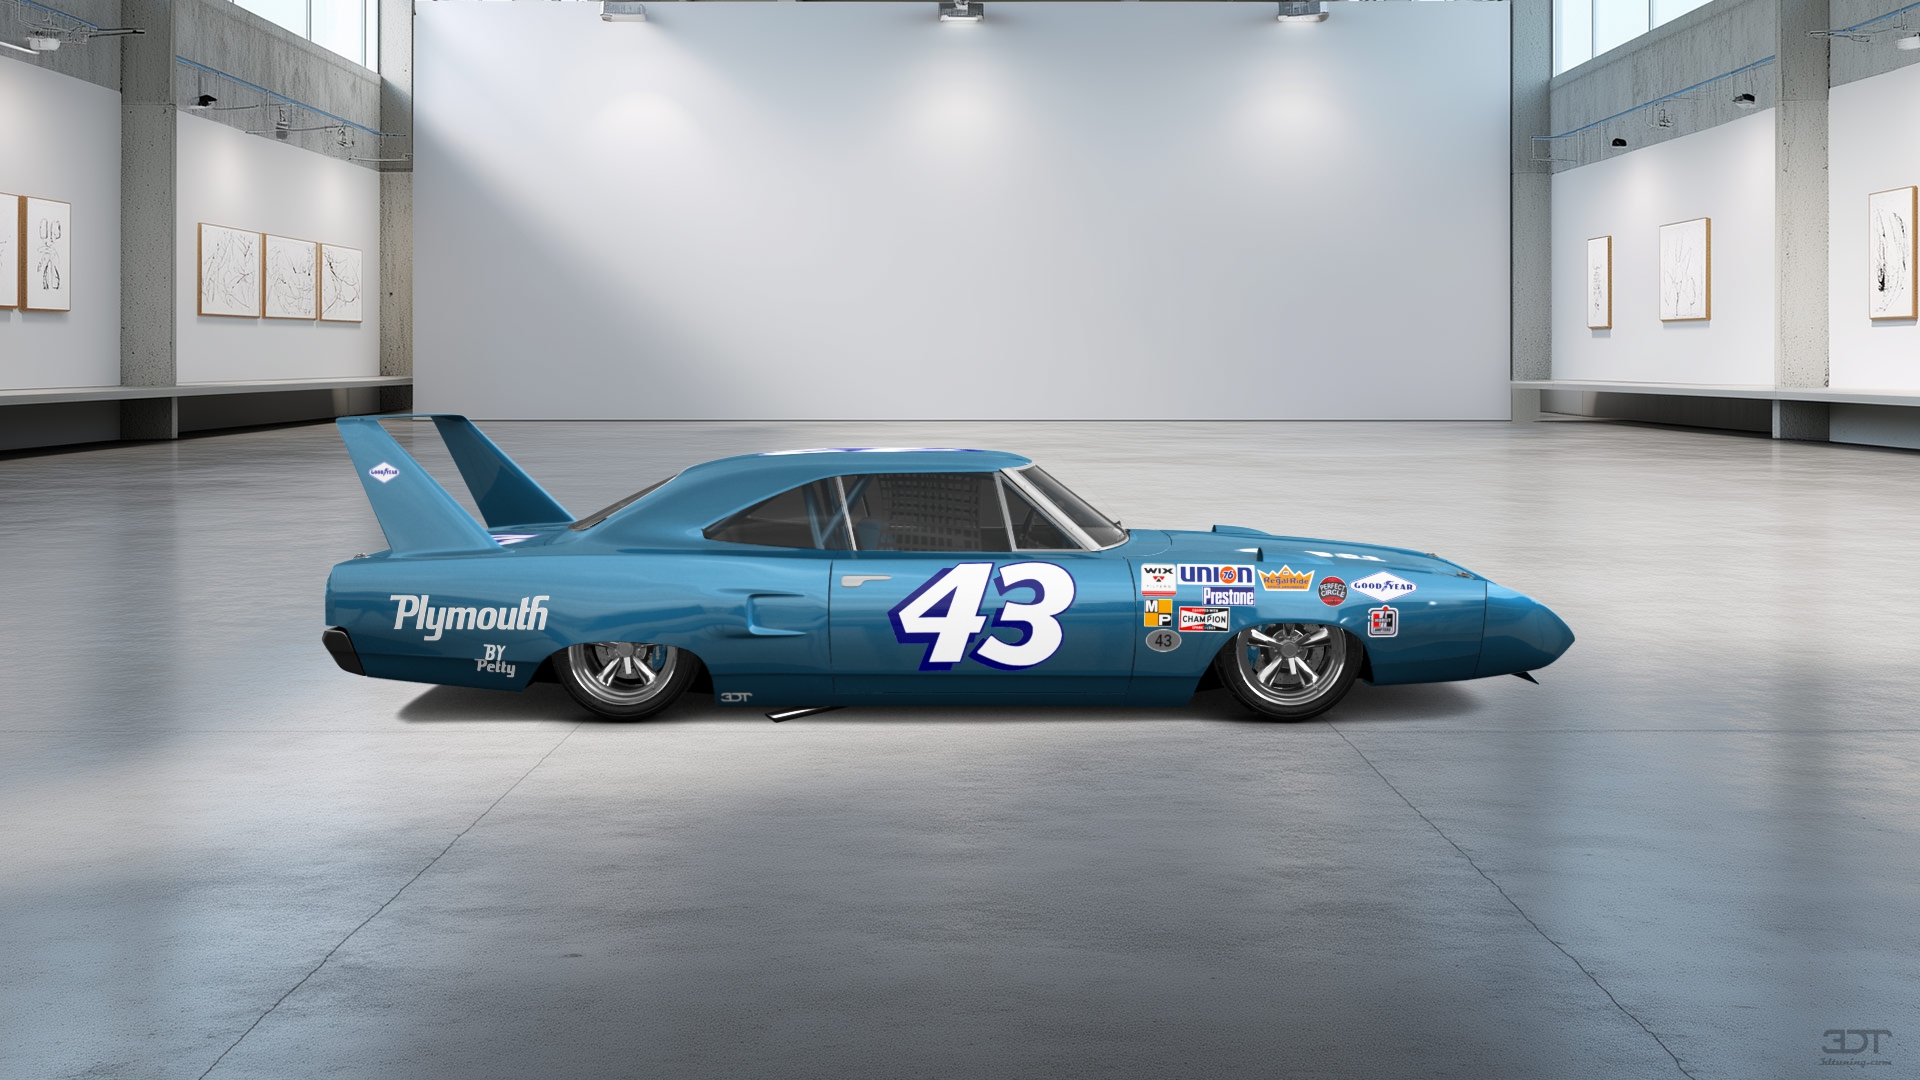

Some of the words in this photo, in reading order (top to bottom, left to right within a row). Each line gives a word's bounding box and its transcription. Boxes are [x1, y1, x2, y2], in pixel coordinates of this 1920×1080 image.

[1222, 571, 1233, 579] 76
[1203, 587, 1254, 605] Prestone
[1321, 590, 1345, 598] CIRCLE
[390, 594, 550, 641] Plymouth
[887, 561, 1077, 671] 43
[1182, 615, 1226, 623] CHAMPION
[1155, 634, 1172, 647] 43
[483, 643, 507, 661] BY
[474, 658, 515, 677] Petty
